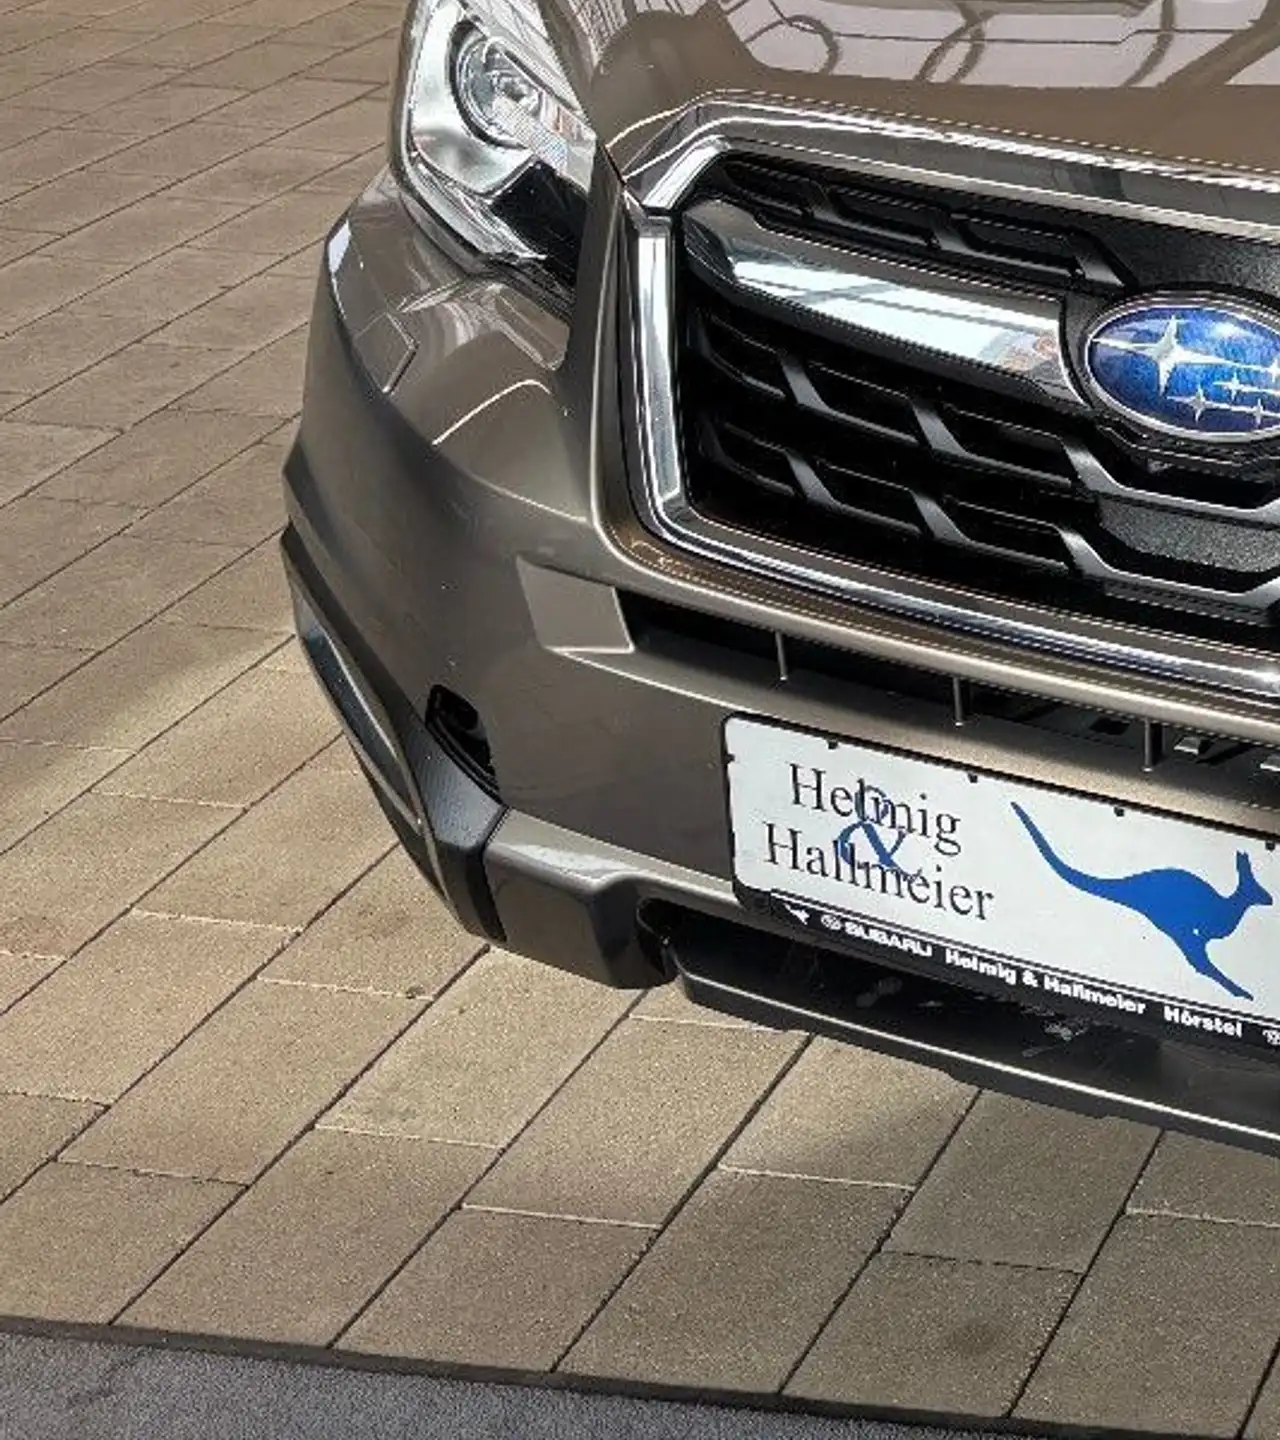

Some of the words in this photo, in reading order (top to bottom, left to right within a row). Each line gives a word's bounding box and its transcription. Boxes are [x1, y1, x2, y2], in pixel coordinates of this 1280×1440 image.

[789, 763, 962, 857] Helmig
[763, 821, 995, 921] Hallmeier
[844, 921, 933, 957] SUBARU
[945, 950, 1017, 986] Helmig
[1022, 969, 1040, 989] &
[1043, 975, 1147, 1015] Hallmeier
[1163, 1005, 1243, 1038] Hörstel
